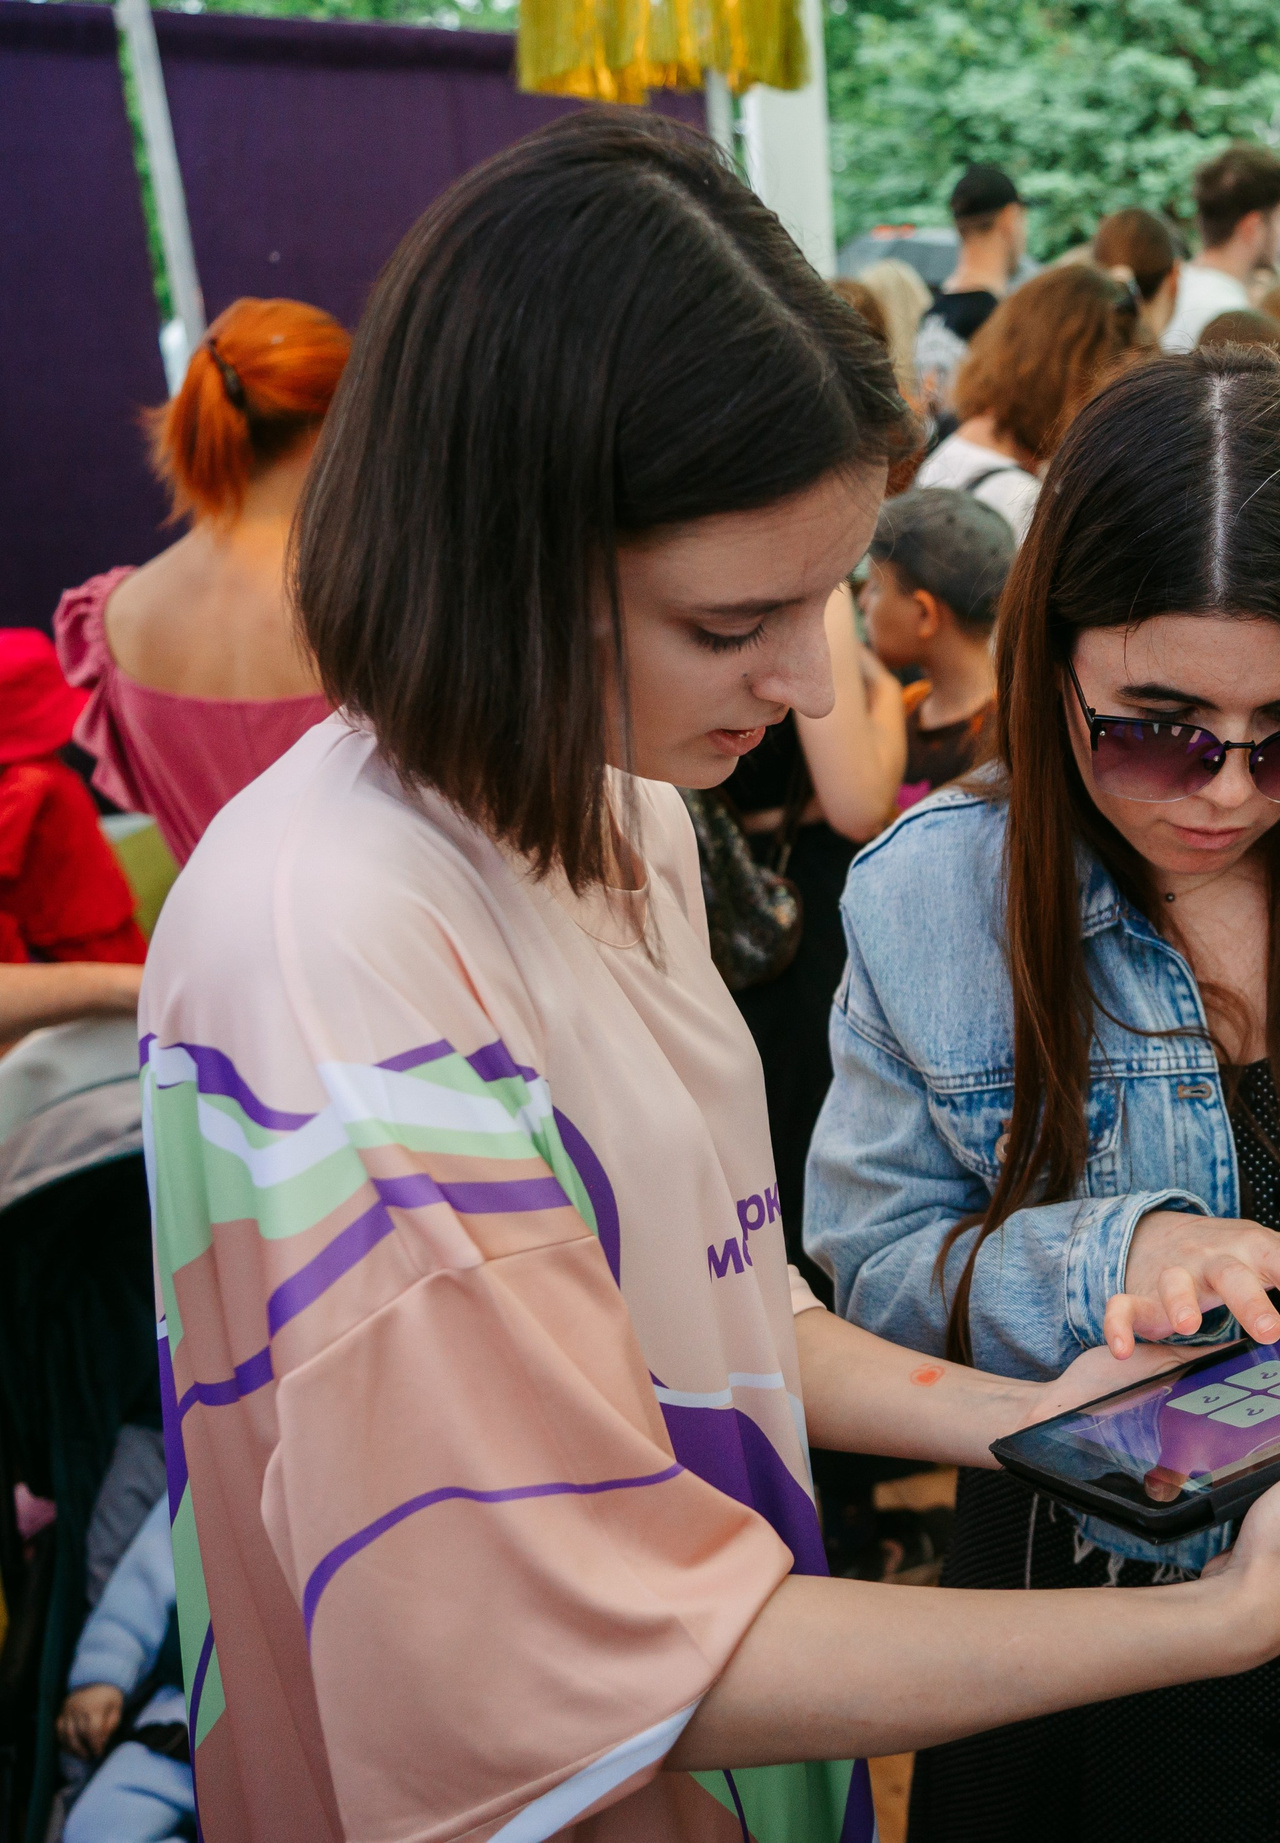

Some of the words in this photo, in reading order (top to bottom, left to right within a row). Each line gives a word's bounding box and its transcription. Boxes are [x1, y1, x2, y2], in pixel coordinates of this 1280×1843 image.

[1260, 1370, 1278, 1380] ?
[1202, 1395, 1220, 1404] ?
[1246, 1406, 1265, 1417] ?
